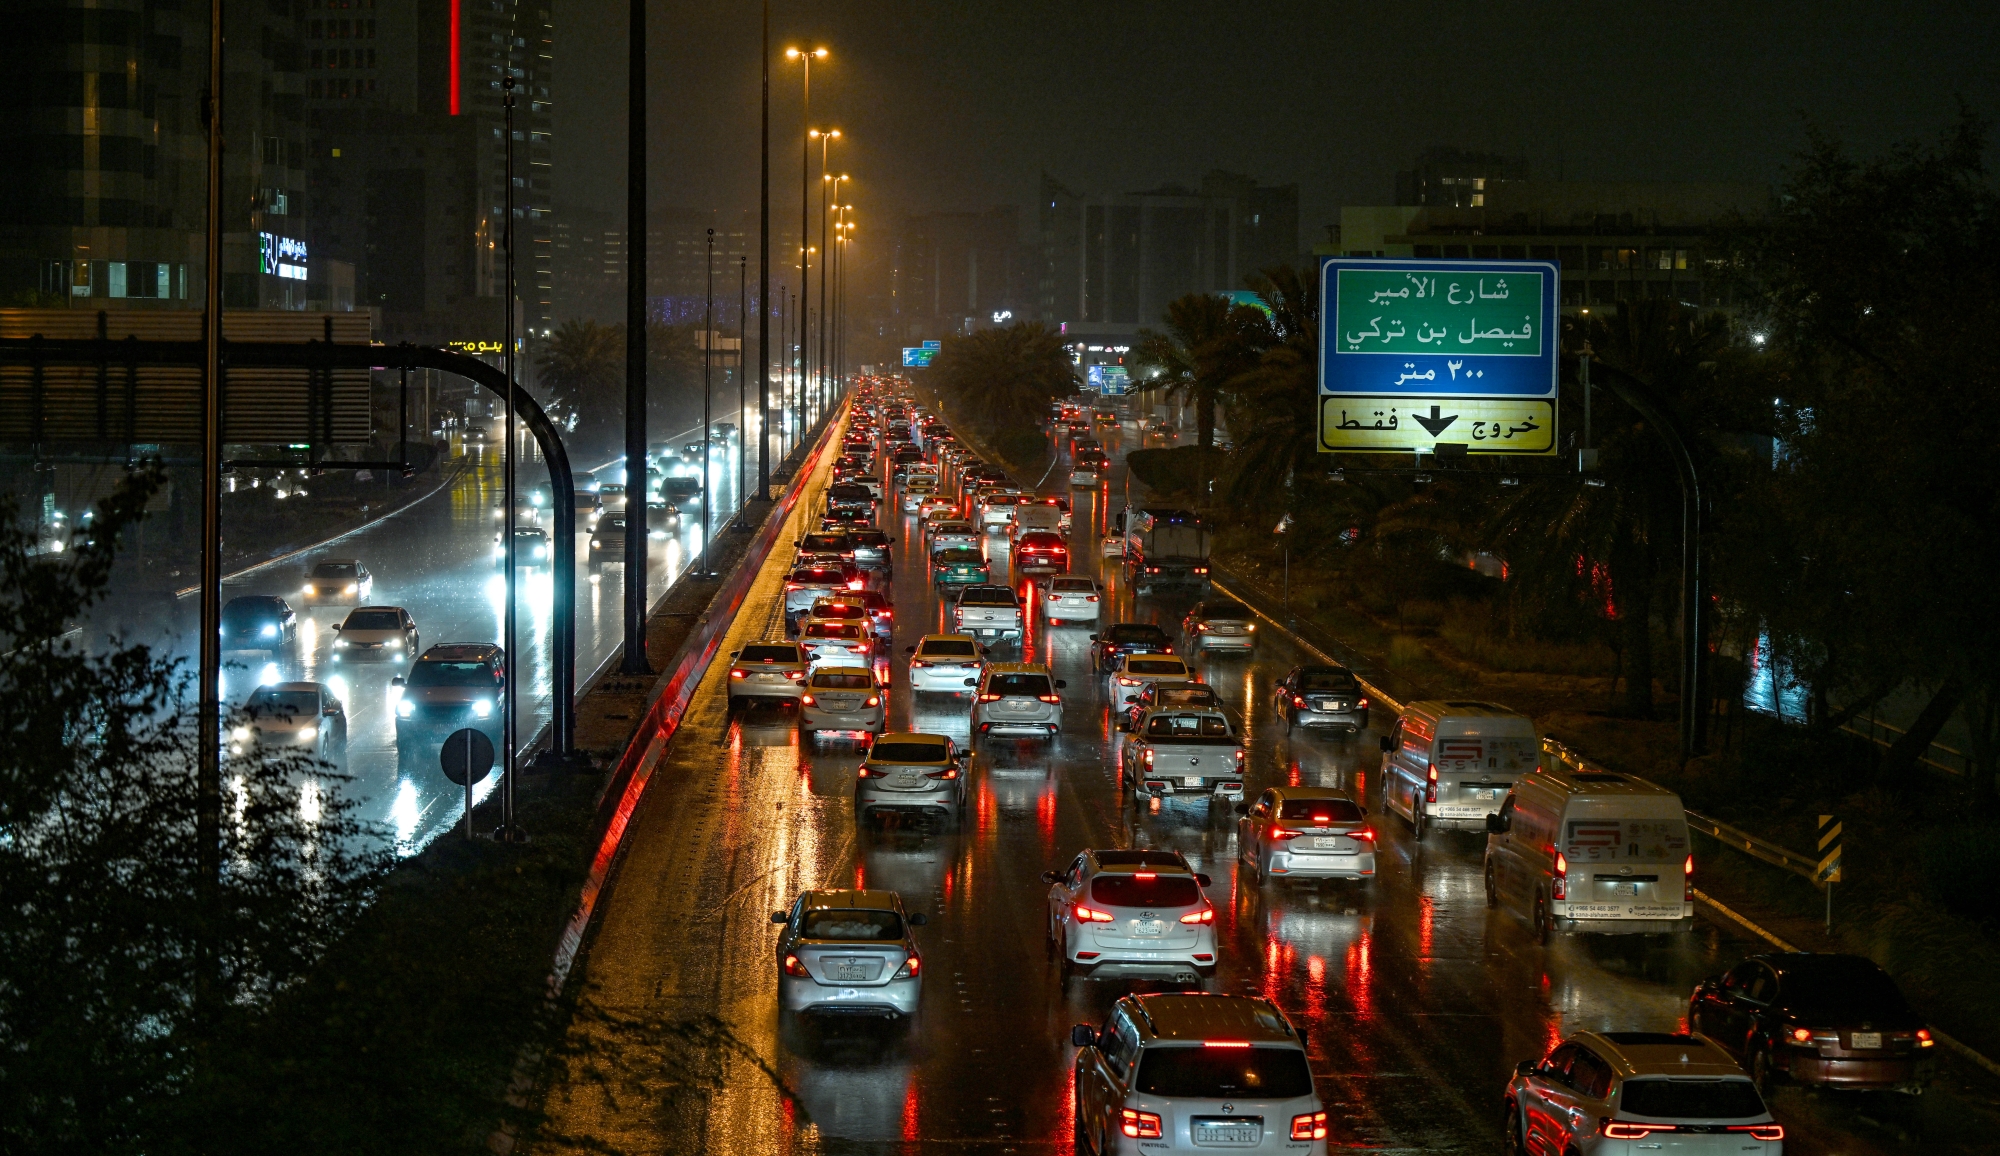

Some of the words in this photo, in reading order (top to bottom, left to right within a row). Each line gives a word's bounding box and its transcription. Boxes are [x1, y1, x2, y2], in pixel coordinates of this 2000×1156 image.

[1368, 272, 1436, 306] الأمير
[1447, 278, 1509, 305] شارع
[1346, 316, 1406, 350] تركي
[1416, 321, 1447, 346] بن
[1458, 315, 1532, 347] فيصل
[1394, 362, 1436, 385] متر
[1447, 359, 1484, 381] ٣٠٠
[1335, 407, 1398, 430] فقط
[1472, 415, 1540, 440] خروج
